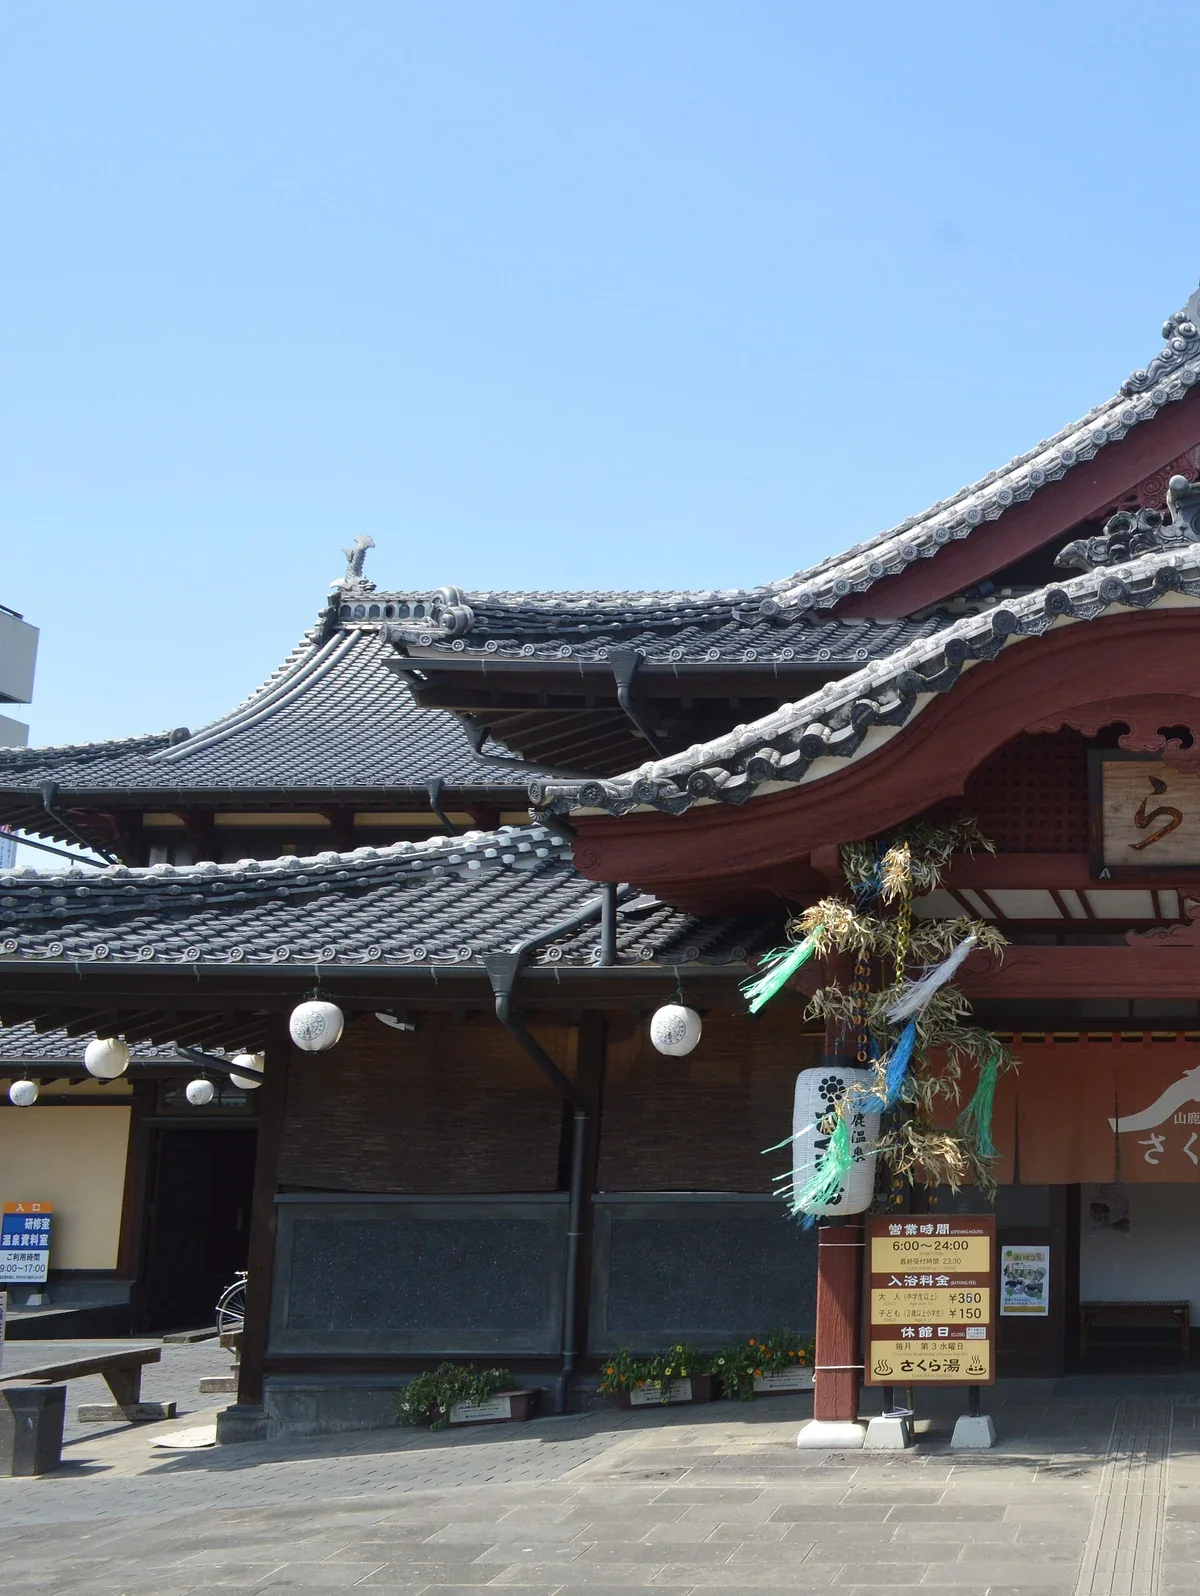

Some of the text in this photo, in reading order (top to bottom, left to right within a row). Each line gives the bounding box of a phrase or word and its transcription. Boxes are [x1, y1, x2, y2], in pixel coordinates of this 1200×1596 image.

[850, 1100, 867, 1163] 鹿温泉
[24, 1218, 50, 1230] 研修室
[888, 1223, 950, 1235] 営業時間
[2, 1234, 48, 1246] 温泉資料室
[888, 1275, 950, 1287] 入浴料金
[878, 1309, 901, 1317] 子ども
[949, 1308, 982, 1319] ¥150
[901, 1326, 949, 1338] 休館日
[895, 1342, 911, 1350] 毎月
[900, 1358, 960, 1373] さくら湯
